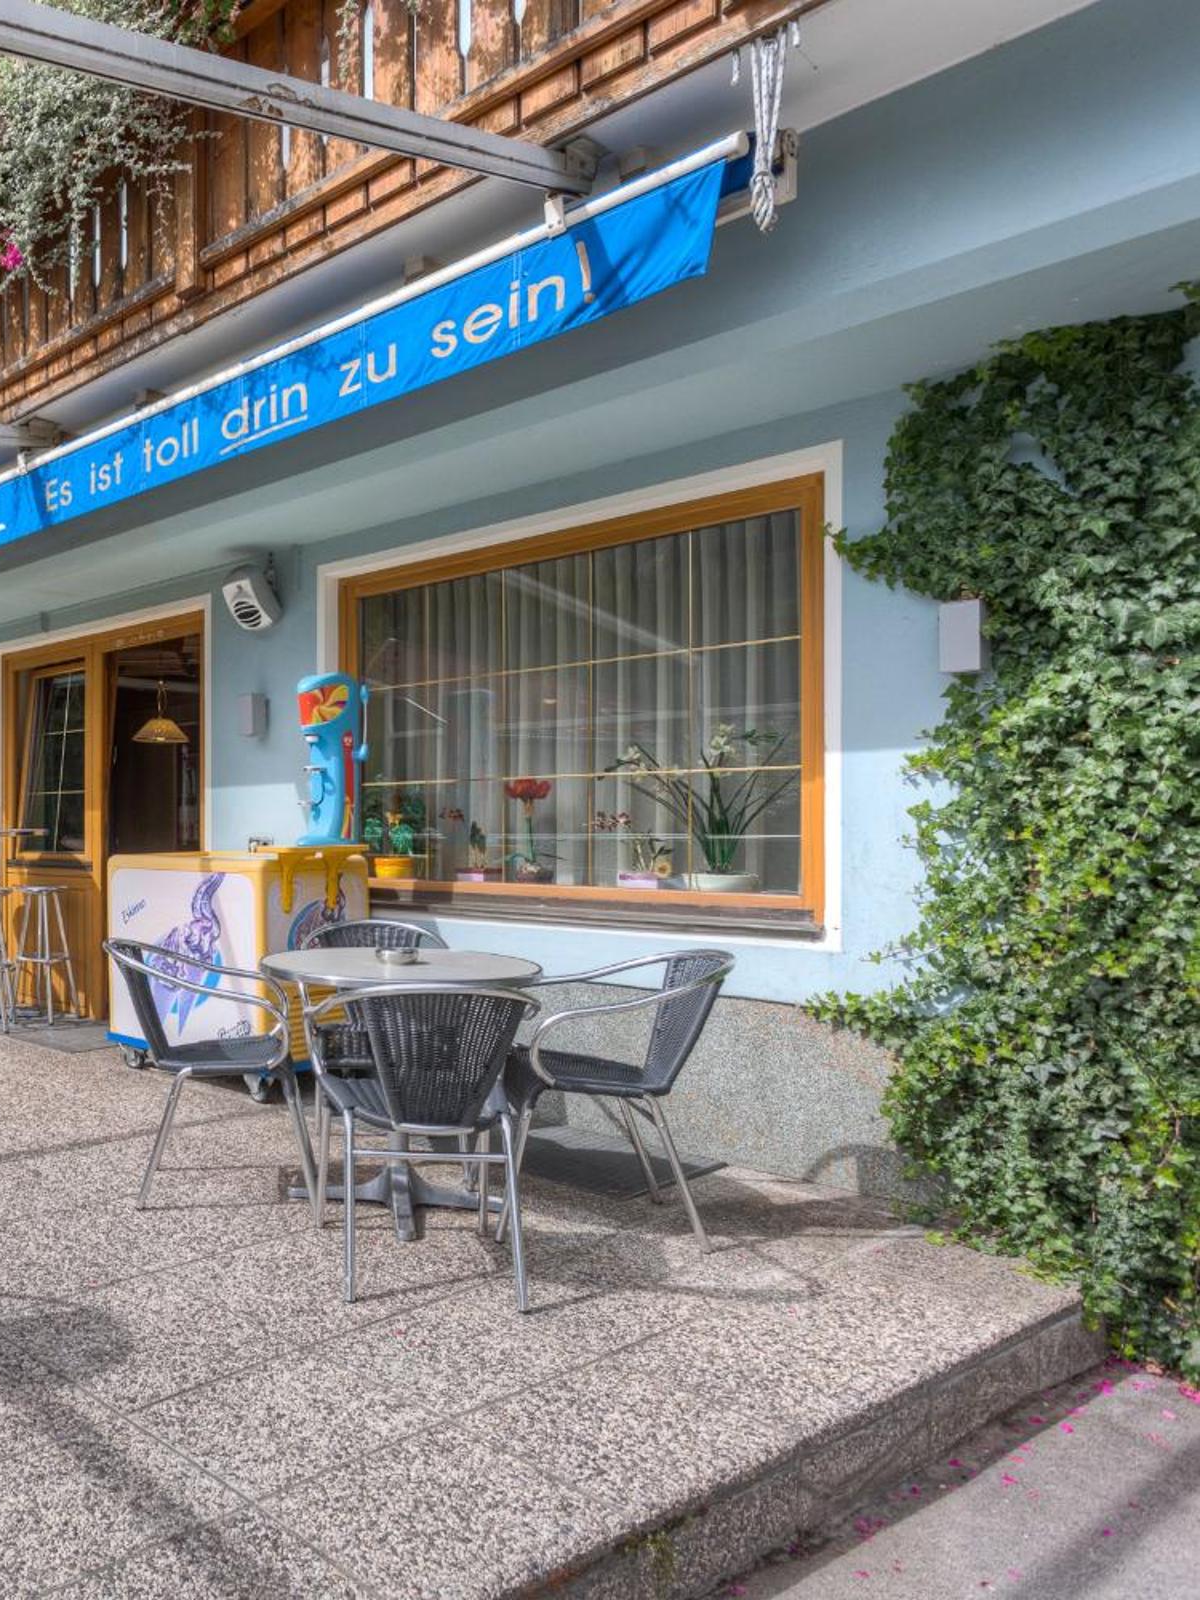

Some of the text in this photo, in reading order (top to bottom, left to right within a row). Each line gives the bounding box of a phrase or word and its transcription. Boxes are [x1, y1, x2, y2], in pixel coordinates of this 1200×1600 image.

[45, 478, 73, 512] Es
[89, 451, 123, 495] ist
[144, 417, 199, 472] toll
[221, 382, 308, 440] drin
[338, 343, 397, 397] zu
[431, 241, 595, 358] sein!
